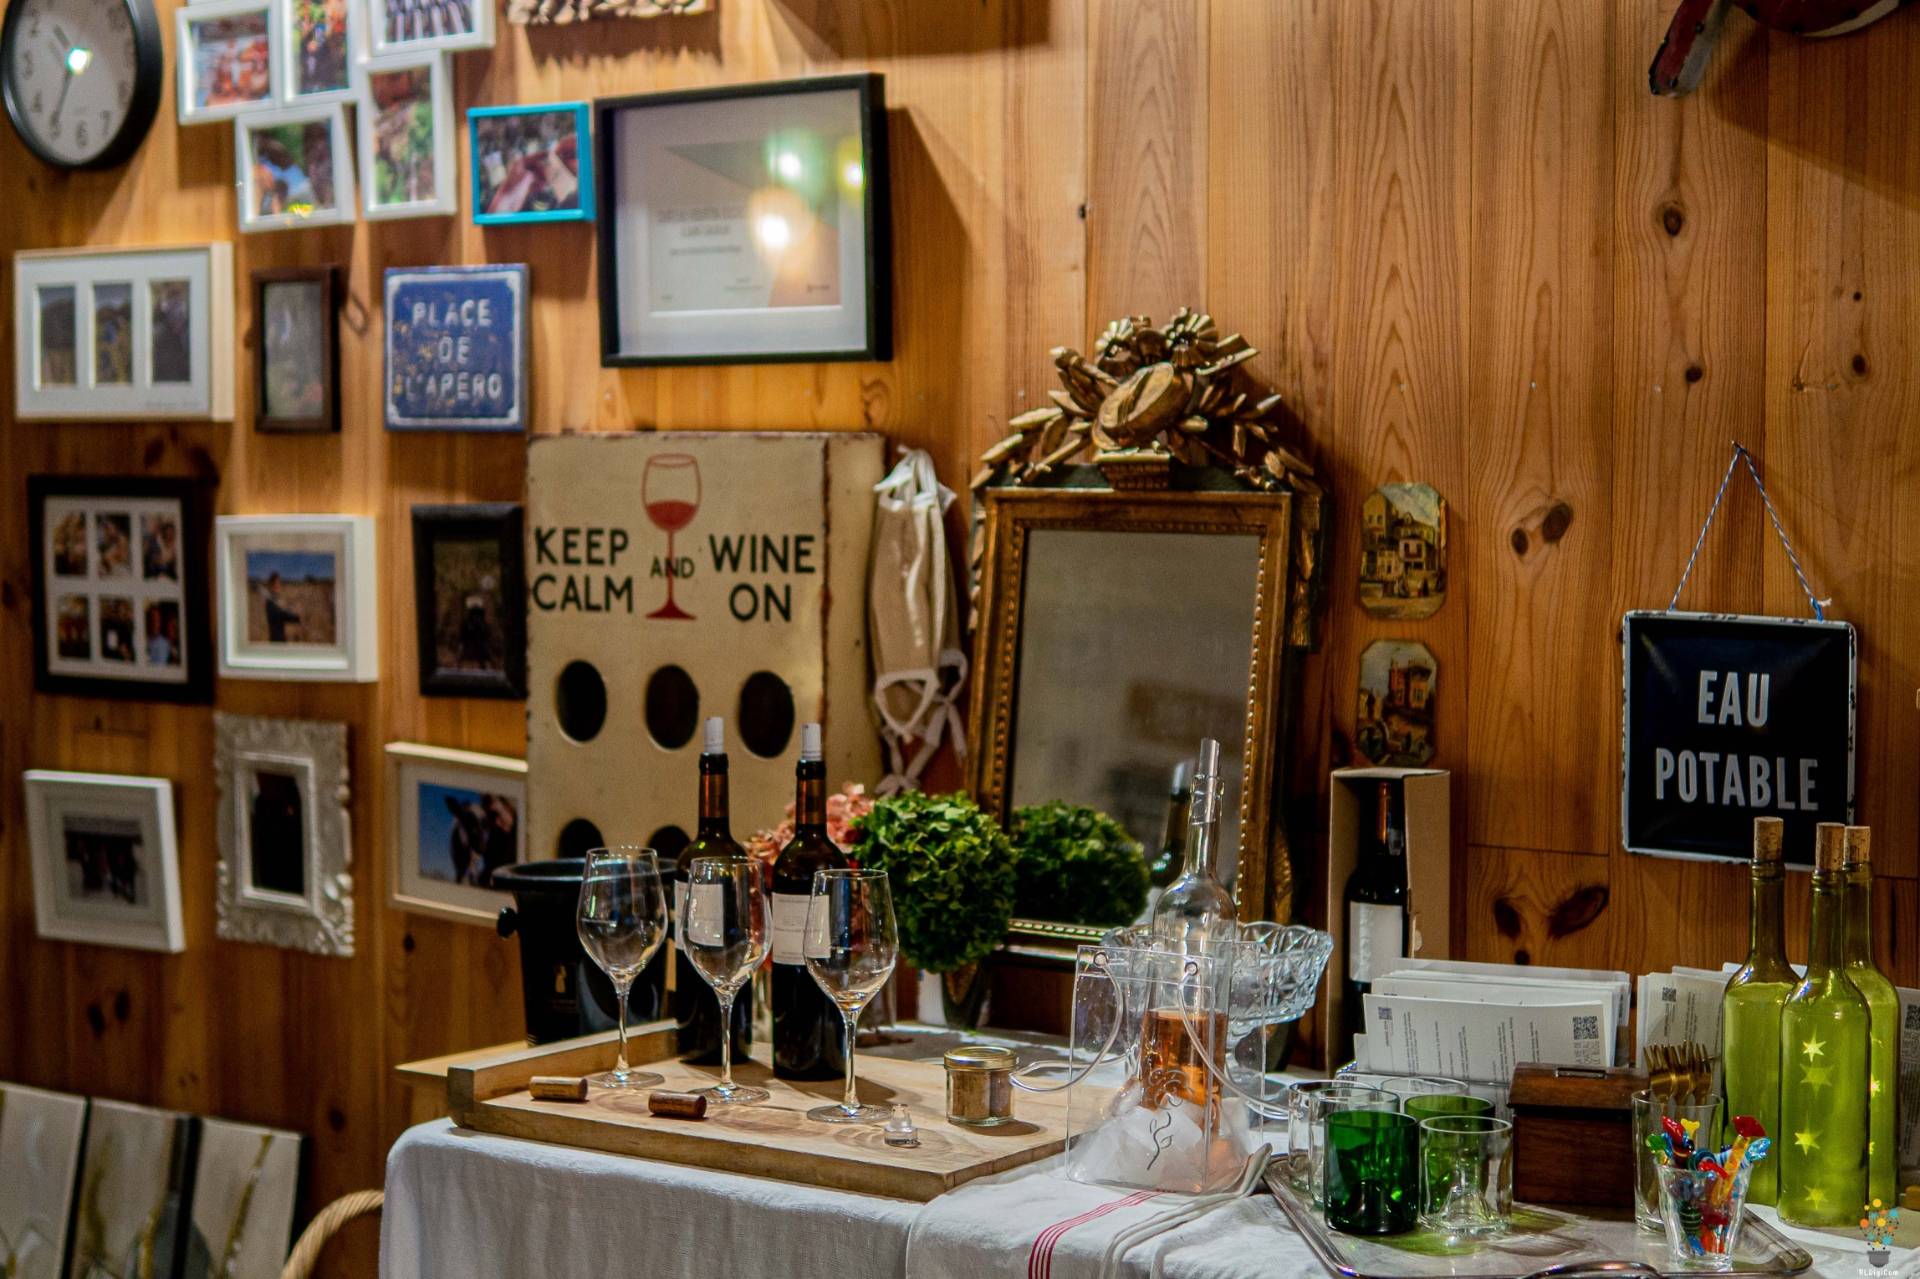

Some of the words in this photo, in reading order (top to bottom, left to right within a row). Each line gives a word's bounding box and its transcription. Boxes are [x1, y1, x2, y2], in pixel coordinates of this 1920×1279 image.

[412, 299, 493, 327] PLACE
[438, 336, 471, 364] DE
[534, 526, 629, 566] KEEP
[709, 533, 816, 574] WINE
[650, 556, 695, 579] AND
[532, 574, 633, 613] CALM
[728, 582, 791, 622] ON
[1698, 669, 1770, 728] EAU
[1656, 747, 1818, 811] POTABLE
